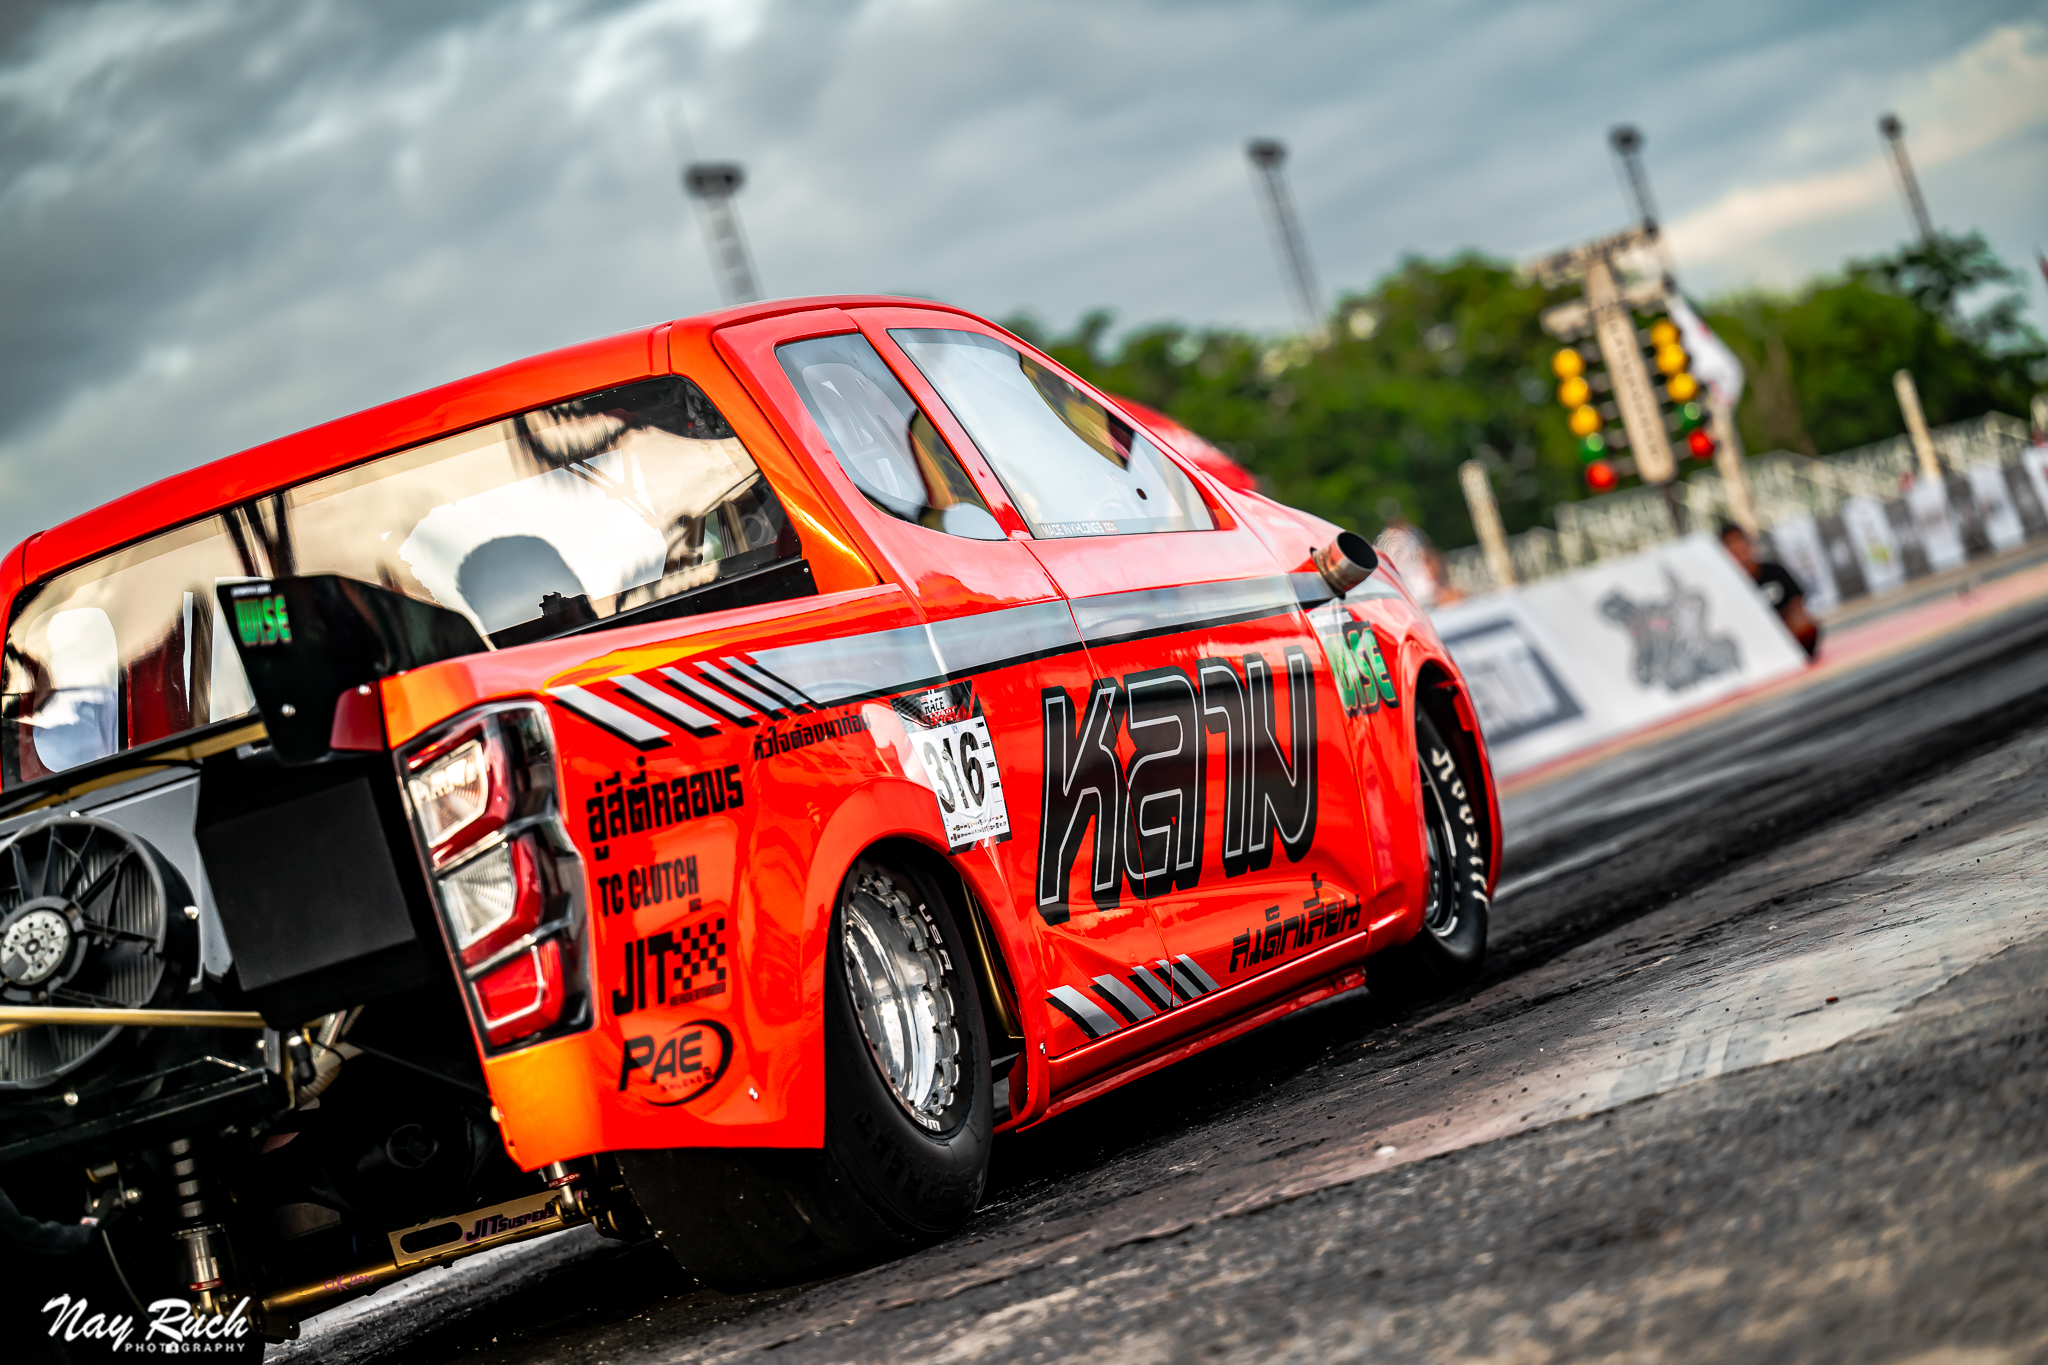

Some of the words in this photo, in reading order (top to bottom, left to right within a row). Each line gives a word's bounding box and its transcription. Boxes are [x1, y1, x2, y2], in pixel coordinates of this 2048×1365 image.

[234, 595, 292, 647] WISE
[1320, 622, 1399, 717] WISE
[921, 697, 944, 714] RACE
[923, 731, 986, 814] 316
[598, 873, 624, 917] TC
[627, 855, 699, 910] CLUTCH
[918, 903, 953, 971] USA
[612, 931, 673, 1017] JIT
[618, 1030, 702, 1092] PAE
[464, 1213, 503, 1244] JIT
